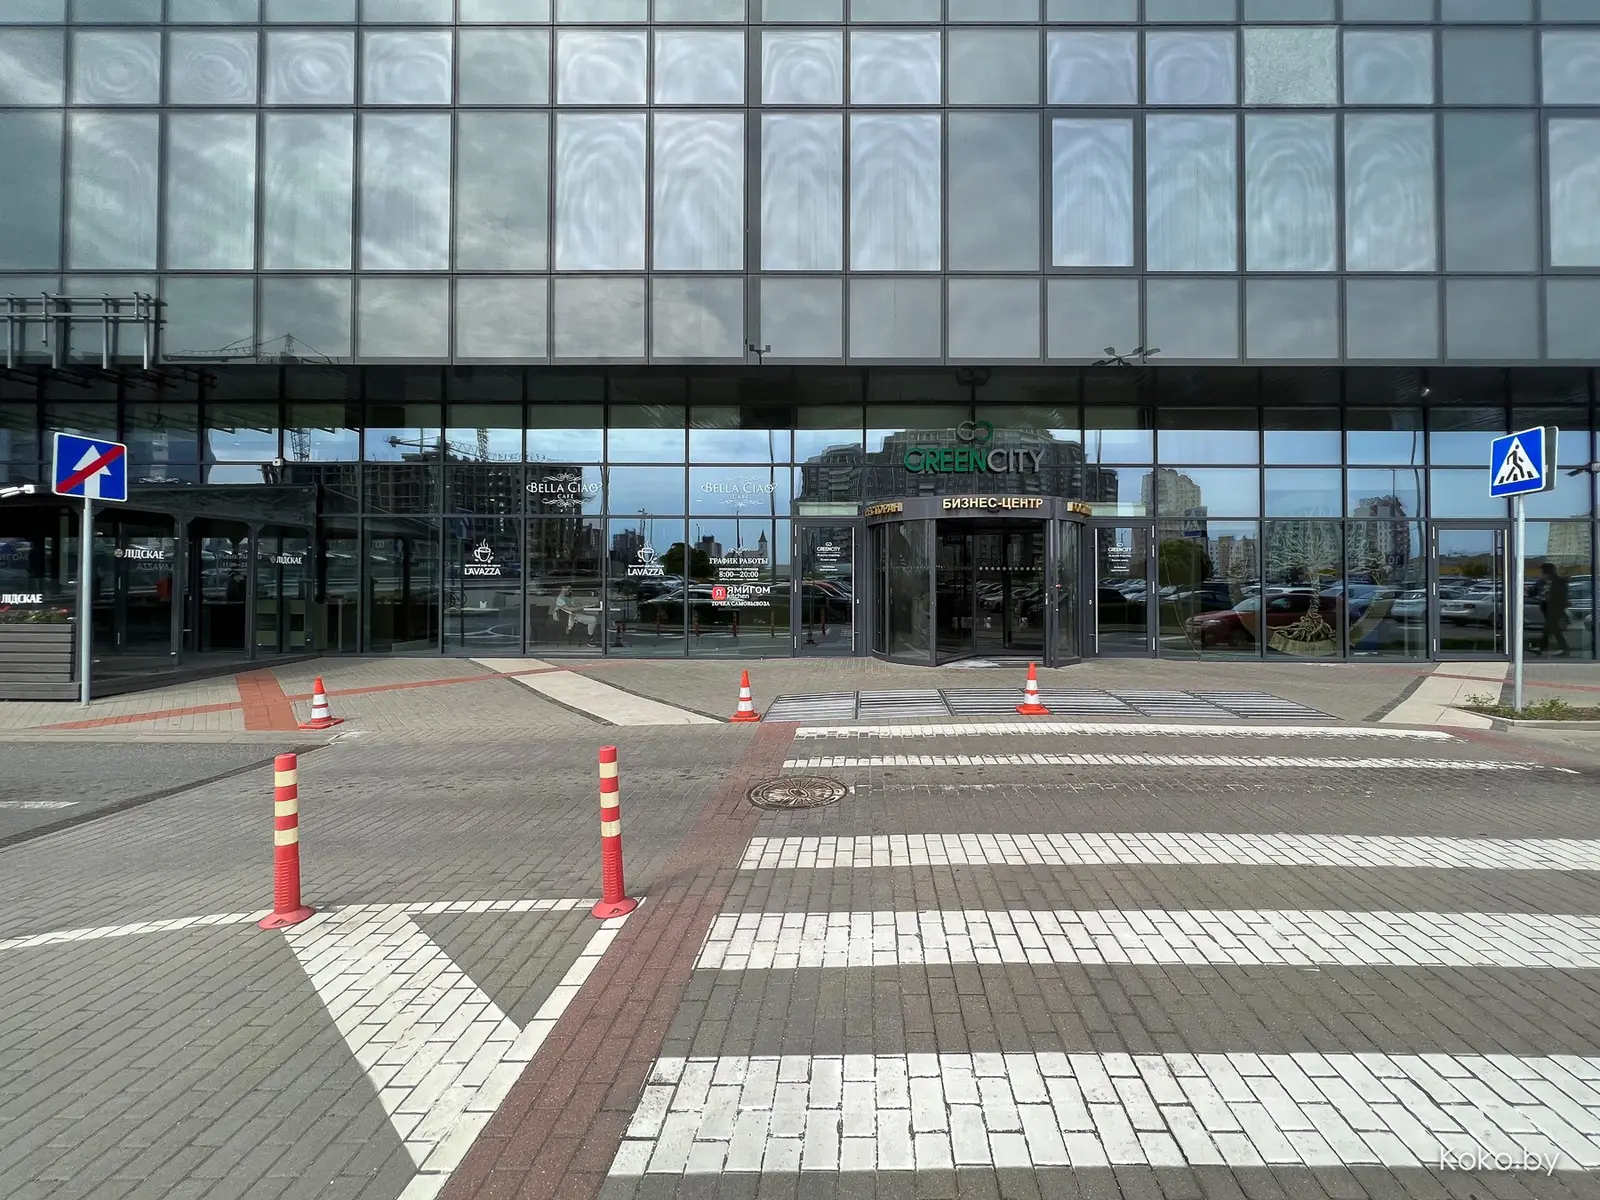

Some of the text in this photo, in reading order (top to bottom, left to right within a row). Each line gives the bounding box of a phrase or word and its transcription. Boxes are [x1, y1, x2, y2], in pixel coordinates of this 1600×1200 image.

[903, 448, 1047, 473] GREENCITY
[526, 481, 603, 493] BELLA CIAO
[701, 482, 778, 494] BELLA CIAO
[942, 497, 1043, 510] БИЗНЕС-ЦЕНТР
[709, 557, 768, 565] ГРАФИК РАБОТЫ
[464, 567, 501, 576] LAVAZZA
[627, 568, 665, 576] LAVAZZA
[727, 585, 771, 594] ЯМИГОМ
